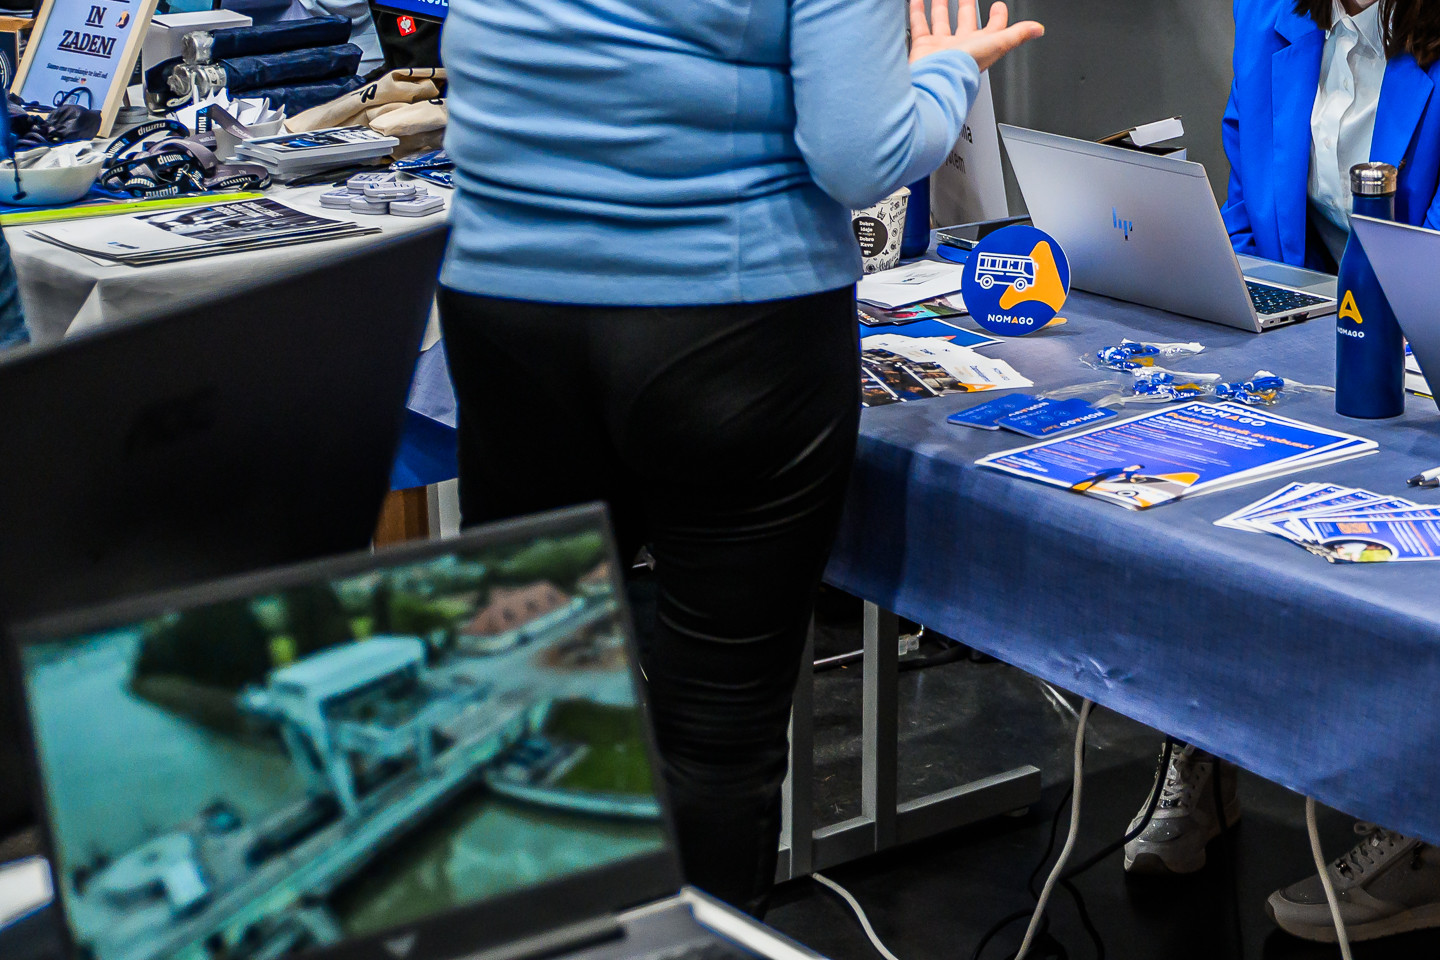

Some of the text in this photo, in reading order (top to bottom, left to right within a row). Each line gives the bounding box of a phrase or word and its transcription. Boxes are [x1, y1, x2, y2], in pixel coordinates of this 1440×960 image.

[86, 5, 107, 25] IN
[58, 29, 117, 56] ZADENI
[137, 121, 166, 136] numip
[157, 154, 184, 166] numip
[987, 314, 1034, 326] NOMAGO
[1187, 405, 1266, 427] NOMAGO
